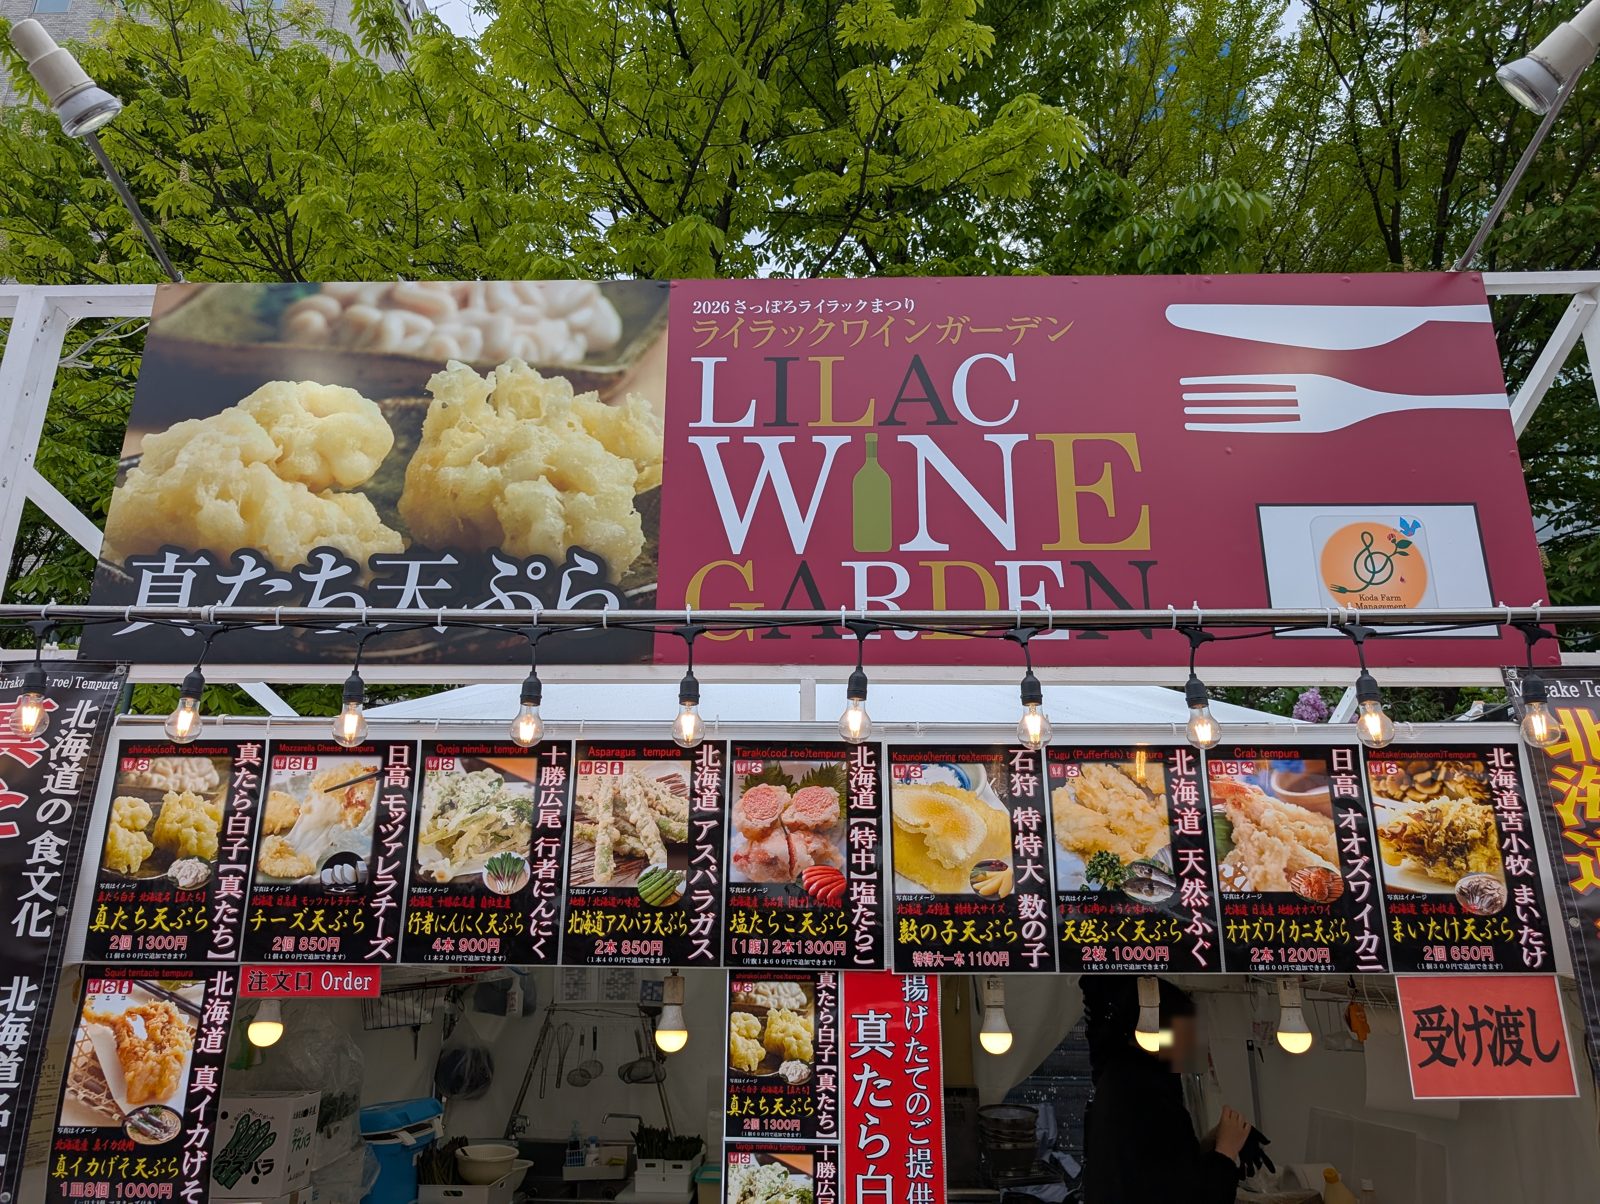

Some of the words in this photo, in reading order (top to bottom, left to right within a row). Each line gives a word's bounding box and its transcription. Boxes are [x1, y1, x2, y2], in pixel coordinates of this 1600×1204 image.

[693, 299, 730, 315] 2026
[734, 297, 916, 315] さっぽろライラックまつり
[691, 315, 1075, 349] ライラックワインガーデン
[688, 352, 1020, 428] LILAC
[112, 551, 622, 636] 真たち天ぷら
[684, 559, 1158, 641] GARDEN
[1358, 594, 1379, 602] Koda
[75, 676, 119, 691] Tempura
[436, 744, 461, 754] Gyoja
[462, 744, 490, 753] ninniku
[493, 744, 529, 754] tempura
[587, 746, 637, 757] Asparagus
[643, 747, 682, 757] tempura
[736, 747, 788, 758] Tarako(cod
[790, 748, 847, 759] roe)tempura
[1049, 750, 1070, 760] Fugu
[1072, 750, 1124, 760] (Pufferfish)
[1234, 749, 1256, 759] Crab
[1260, 749, 1299, 760] tempura
[384, 745, 411, 788] 日高
[692, 744, 721, 812] 北海道
[1009, 749, 1038, 797] 石狩
[1331, 749, 1359, 798] 日高
[537, 745, 567, 829] 十勝広尾
[1168, 749, 1201, 836] 北海道
[10, 699, 99, 938] 北海道の食文化
[207, 743, 261, 959] 真たら白子【真たち】
[1012, 806, 1045, 884] 特特大
[1486, 747, 1535, 876] 北海道苫小牧
[1513, 884, 1548, 969] まいたけ
[364, 793, 407, 960] モッツァレラチーズ
[687, 819, 718, 960] アスパラガス
[1337, 808, 1384, 970] オオズワイカニ
[530, 836, 561, 959] 行者にんにく
[1178, 848, 1211, 966] 天然ふぐ
[89, 904, 209, 932] 真たち天ぷら
[250, 907, 364, 934] チーズ天ぷら
[408, 911, 524, 935] 行者にんにく天ぷら
[568, 909, 689, 937] 北海道アスパラ天ぷら
[729, 910, 849, 936] 塩たらこ天ぷら
[1018, 893, 1050, 968] 数の子
[1061, 917, 1183, 944] 天然ふぐ天ぷら
[1226, 917, 1351, 945] オオズワイカニ天ぷら
[1391, 916, 1515, 943] まいたけ天ぷら
[109, 935, 133, 950] 2個
[137, 935, 188, 950] 1300円
[272, 936, 296, 952] 2個
[298, 936, 341, 952] 850円
[432, 938, 455, 953] 4本
[459, 938, 500, 953] 900円
[594, 940, 617, 956] 2本
[621, 940, 664, 956] 850円
[1081, 946, 1106, 962] 2枚
[1112, 946, 1170, 962] 1000円
[1250, 947, 1274, 963] 2本
[1278, 947, 1331, 963] 1200円
[1423, 945, 1447, 962] 2個
[1450, 945, 1495, 962] 650円
[912, 951, 965, 967] 特特大一本
[968, 951, 1010, 967] 1100円
[105, 968, 126, 978] Squid
[128, 968, 159, 978] tentacle
[161, 969, 194, 979] tempura
[247, 970, 313, 992] 注文口
[320, 970, 373, 991] Order
[196, 971, 233, 1053] 北海道
[1412, 1004, 1561, 1069] 受け渡し
[816, 971, 838, 1138] 真たら白子【真たち】
[902, 973, 934, 1204] 揚げたてのご提供
[727, 1094, 815, 1117] 真たち天ぷら
[57, 1127, 98, 1135] 写真はイメージ
[180, 1065, 220, 1204] 真イカげそ
[743, 1118, 760, 1130] 2個
[763, 1118, 801, 1131] 1300円
[52, 1154, 179, 1179] 真イカげそ天ぷら
[60, 1181, 110, 1198] 1皿8個
[115, 1181, 173, 1199] 1000円
